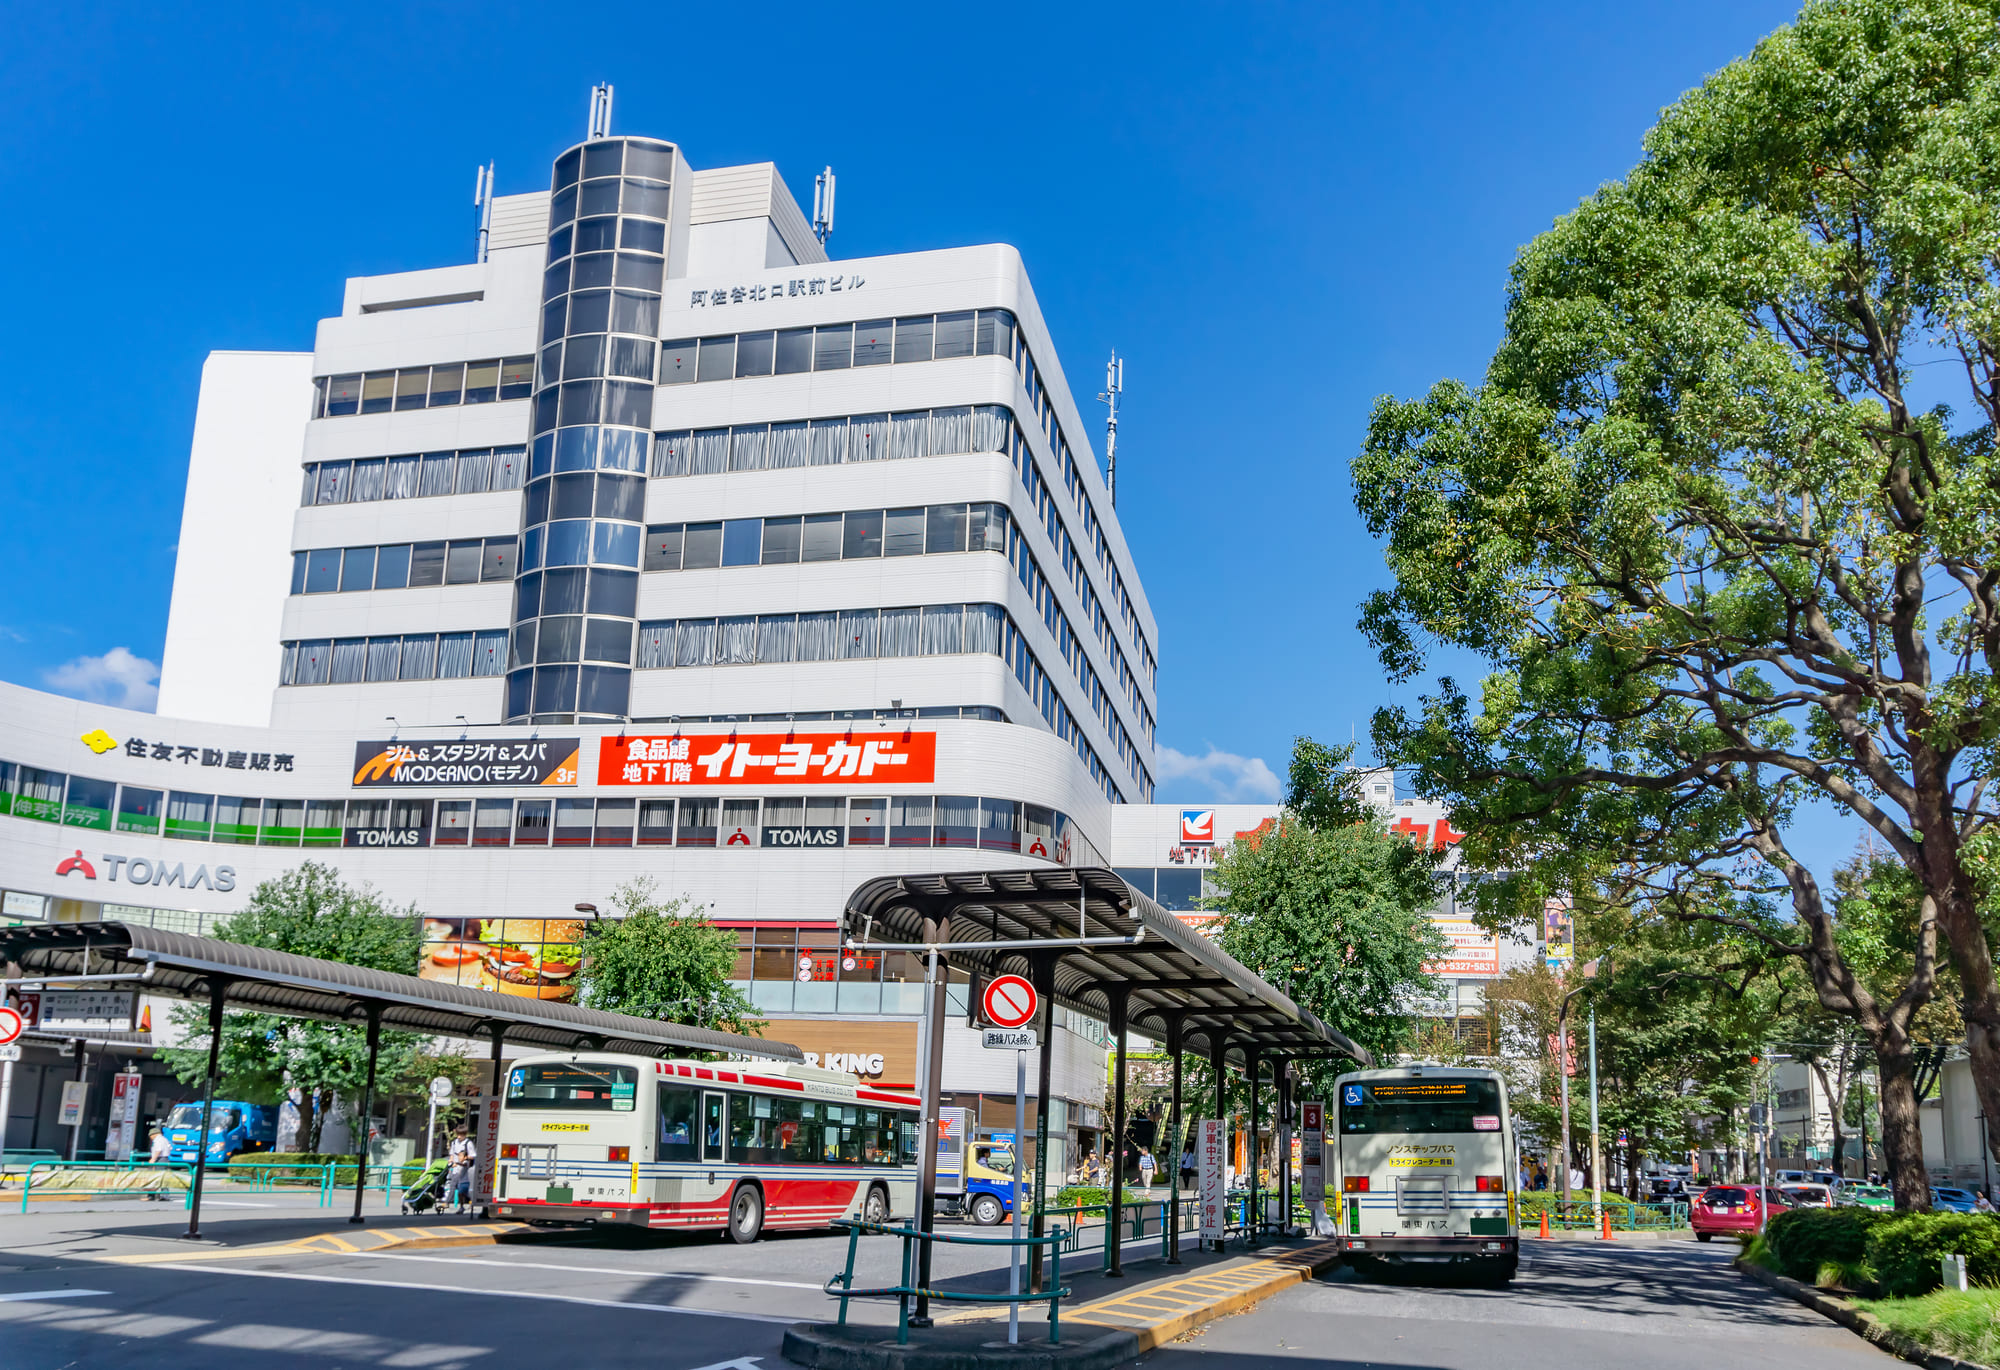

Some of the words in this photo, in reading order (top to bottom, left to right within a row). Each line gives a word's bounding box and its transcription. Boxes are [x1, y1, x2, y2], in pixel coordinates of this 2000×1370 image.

[690, 275, 866, 308] 阿佐谷北口駅前ビル
[124, 736, 295, 772] 住友不動産販売
[385, 743, 547, 763] ジム&スタジオ&スパ
[627, 738, 691, 761] 食品館
[697, 740, 908, 777] イトーヨーカドー
[556, 768, 577, 783] 3F
[622, 763, 692, 782] 地下1階
[357, 830, 419, 845] TOMAS
[769, 829, 838, 845] TOMAS
[102, 854, 236, 893] TOMAS
[987, 1033, 1032, 1045] 路線バスを除く
[824, 1052, 884, 1075] KING
[1308, 1112, 1317, 1125] 3
[482, 1100, 499, 1194] 停車中エンジン停止
[1386, 1144, 1456, 1154] ノンステップバス
[1205, 1121, 1217, 1228] 停車中エンジン停止
[588, 1187, 625, 1196] 関東バス
[1401, 1220, 1448, 1230] 関東バス
